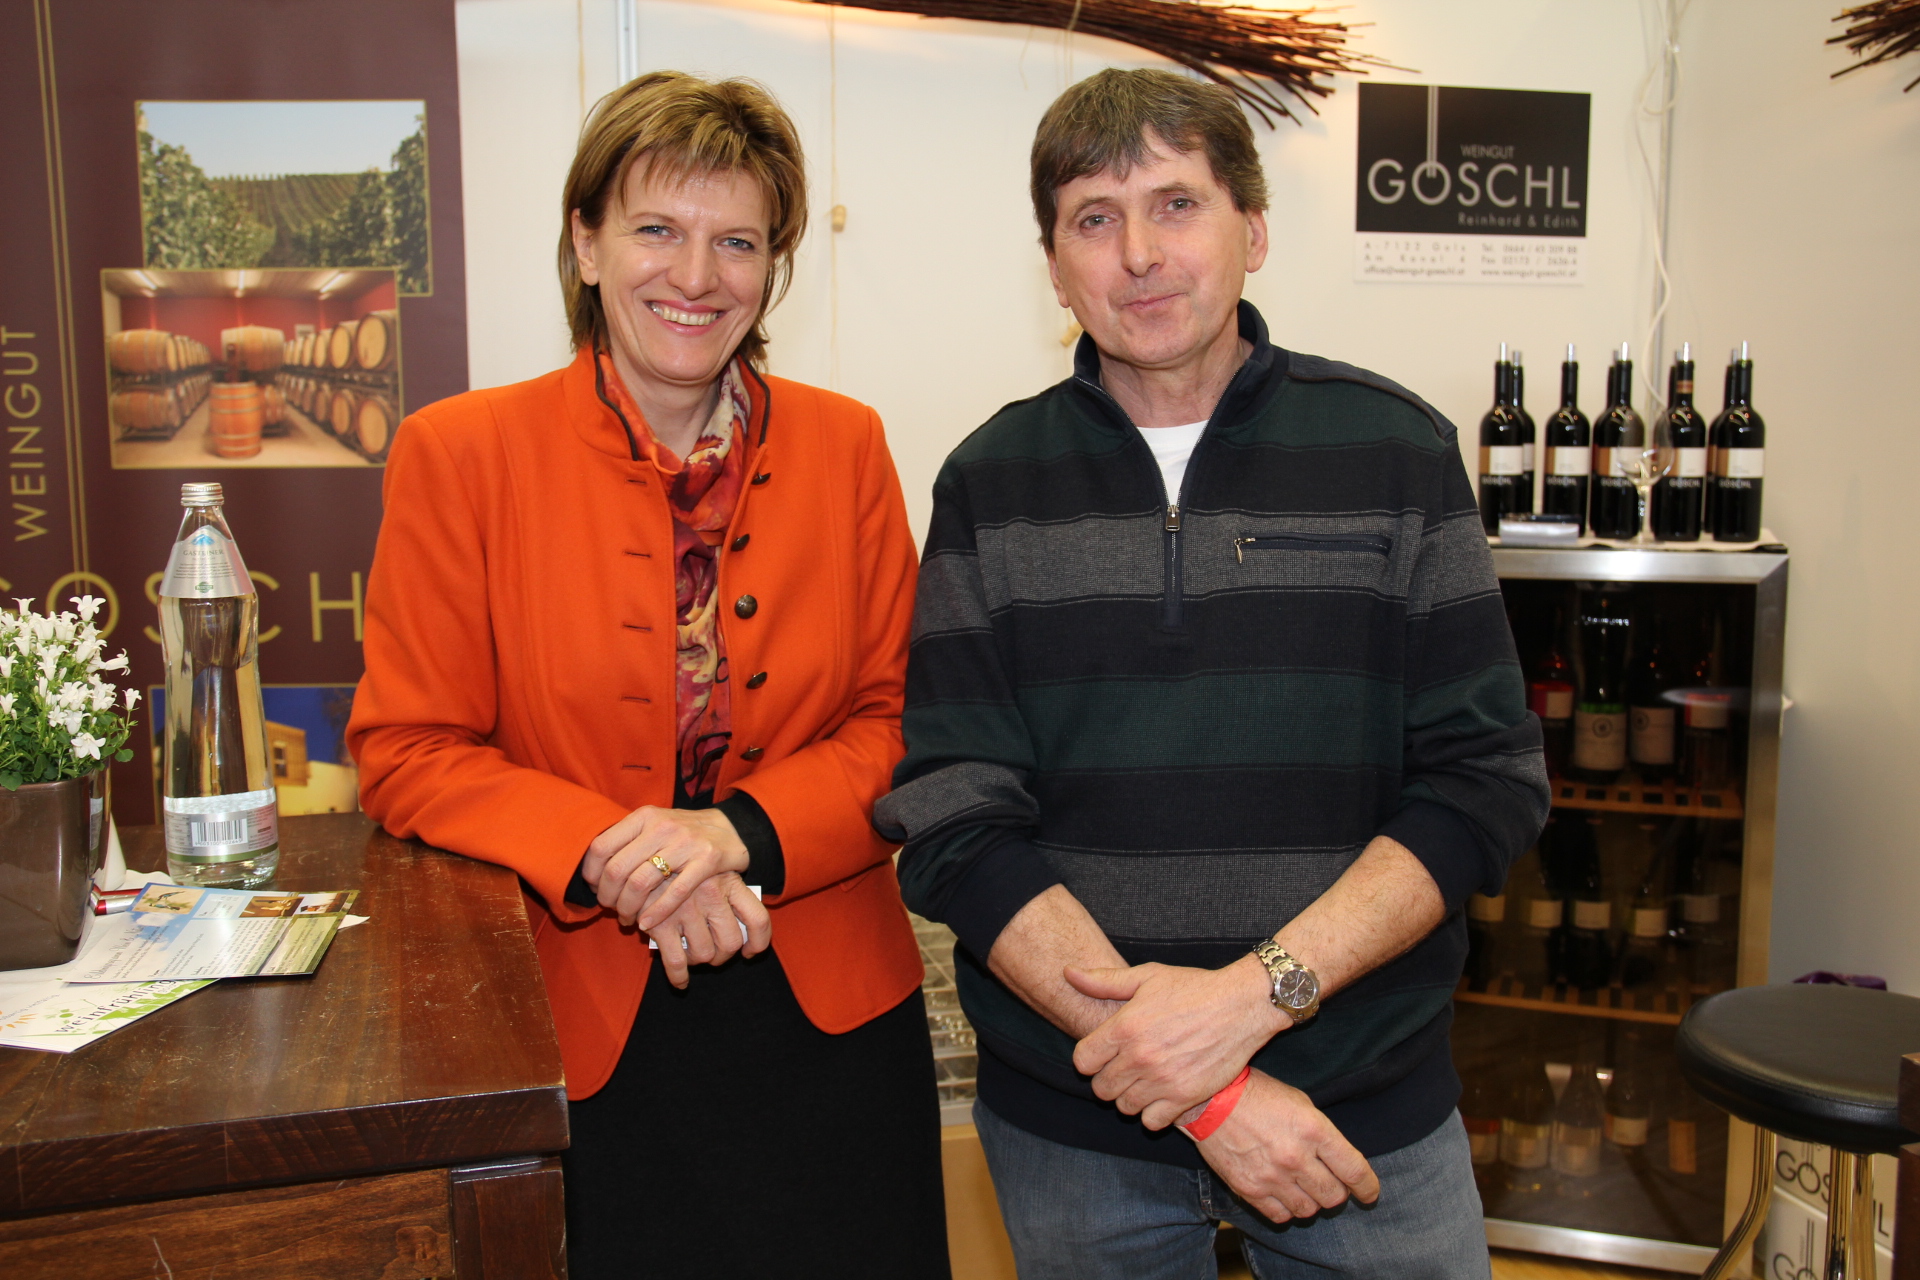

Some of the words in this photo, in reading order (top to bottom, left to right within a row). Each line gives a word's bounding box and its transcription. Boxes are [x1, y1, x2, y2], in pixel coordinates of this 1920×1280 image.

[1460, 144, 1515, 159] WEINGUT
[1457, 211, 1522, 228] Reinhard
[1526, 214, 1537, 229] &
[1543, 214, 1580, 229] Edith
[1, 325, 49, 542] WEINGUT
[182, 548, 225, 557] GASTEINER
[55, 979, 178, 1033] weinfrühling
